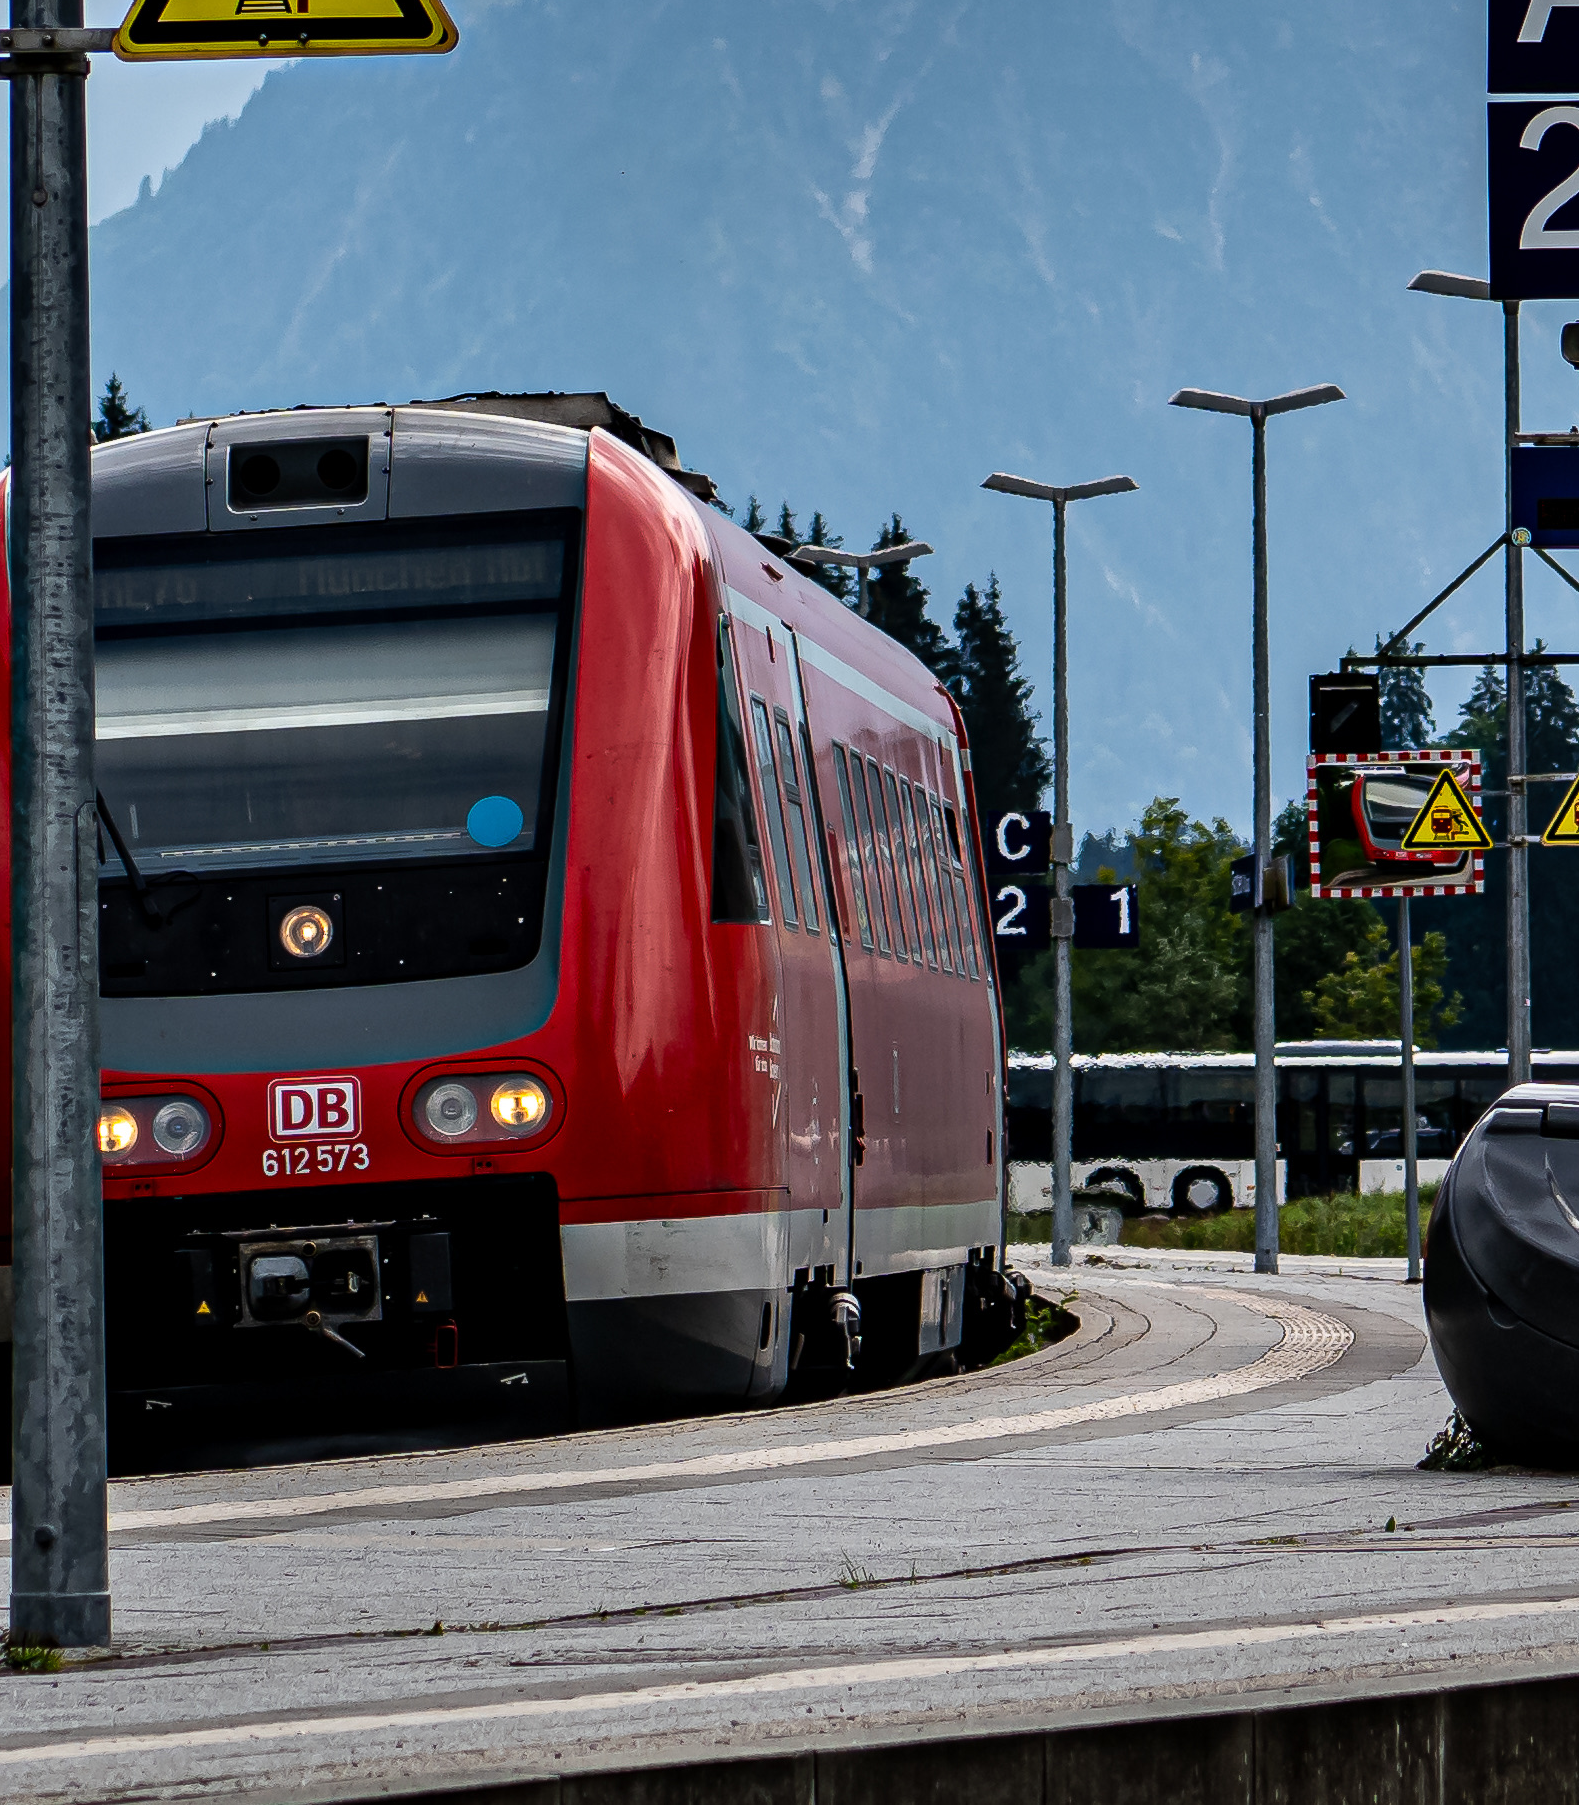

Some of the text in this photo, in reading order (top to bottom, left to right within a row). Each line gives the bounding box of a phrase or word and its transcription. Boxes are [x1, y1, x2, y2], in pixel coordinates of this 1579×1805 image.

[996, 812, 1031, 861] C
[996, 885, 1027, 935] 2
[1110, 887, 1130, 934] 1
[279, 1086, 351, 1134] DB
